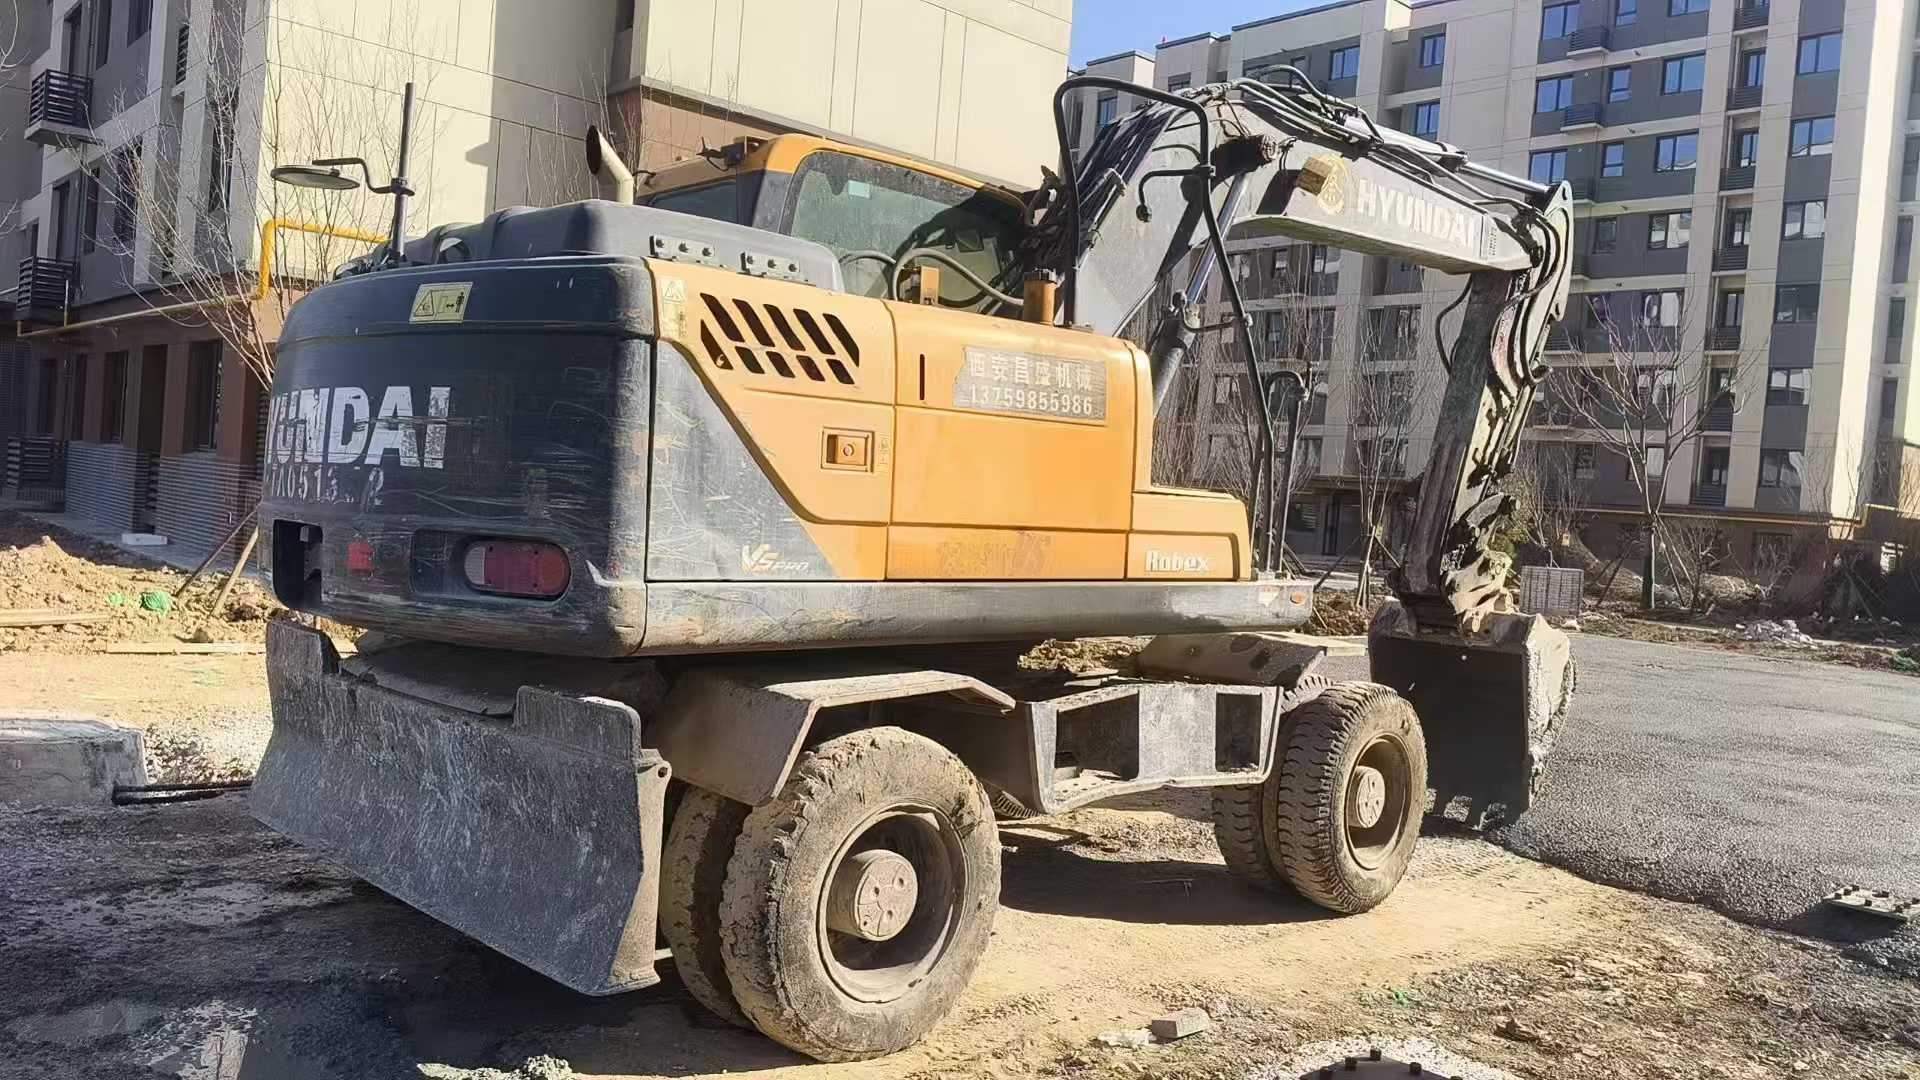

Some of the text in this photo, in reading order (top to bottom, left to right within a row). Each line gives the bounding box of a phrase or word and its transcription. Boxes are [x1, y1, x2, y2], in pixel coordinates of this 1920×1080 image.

[1358, 178, 1476, 249] HYUNDAI
[969, 352, 1093, 390] 西安昌盛机械
[1145, 550, 1208, 572] Robex
